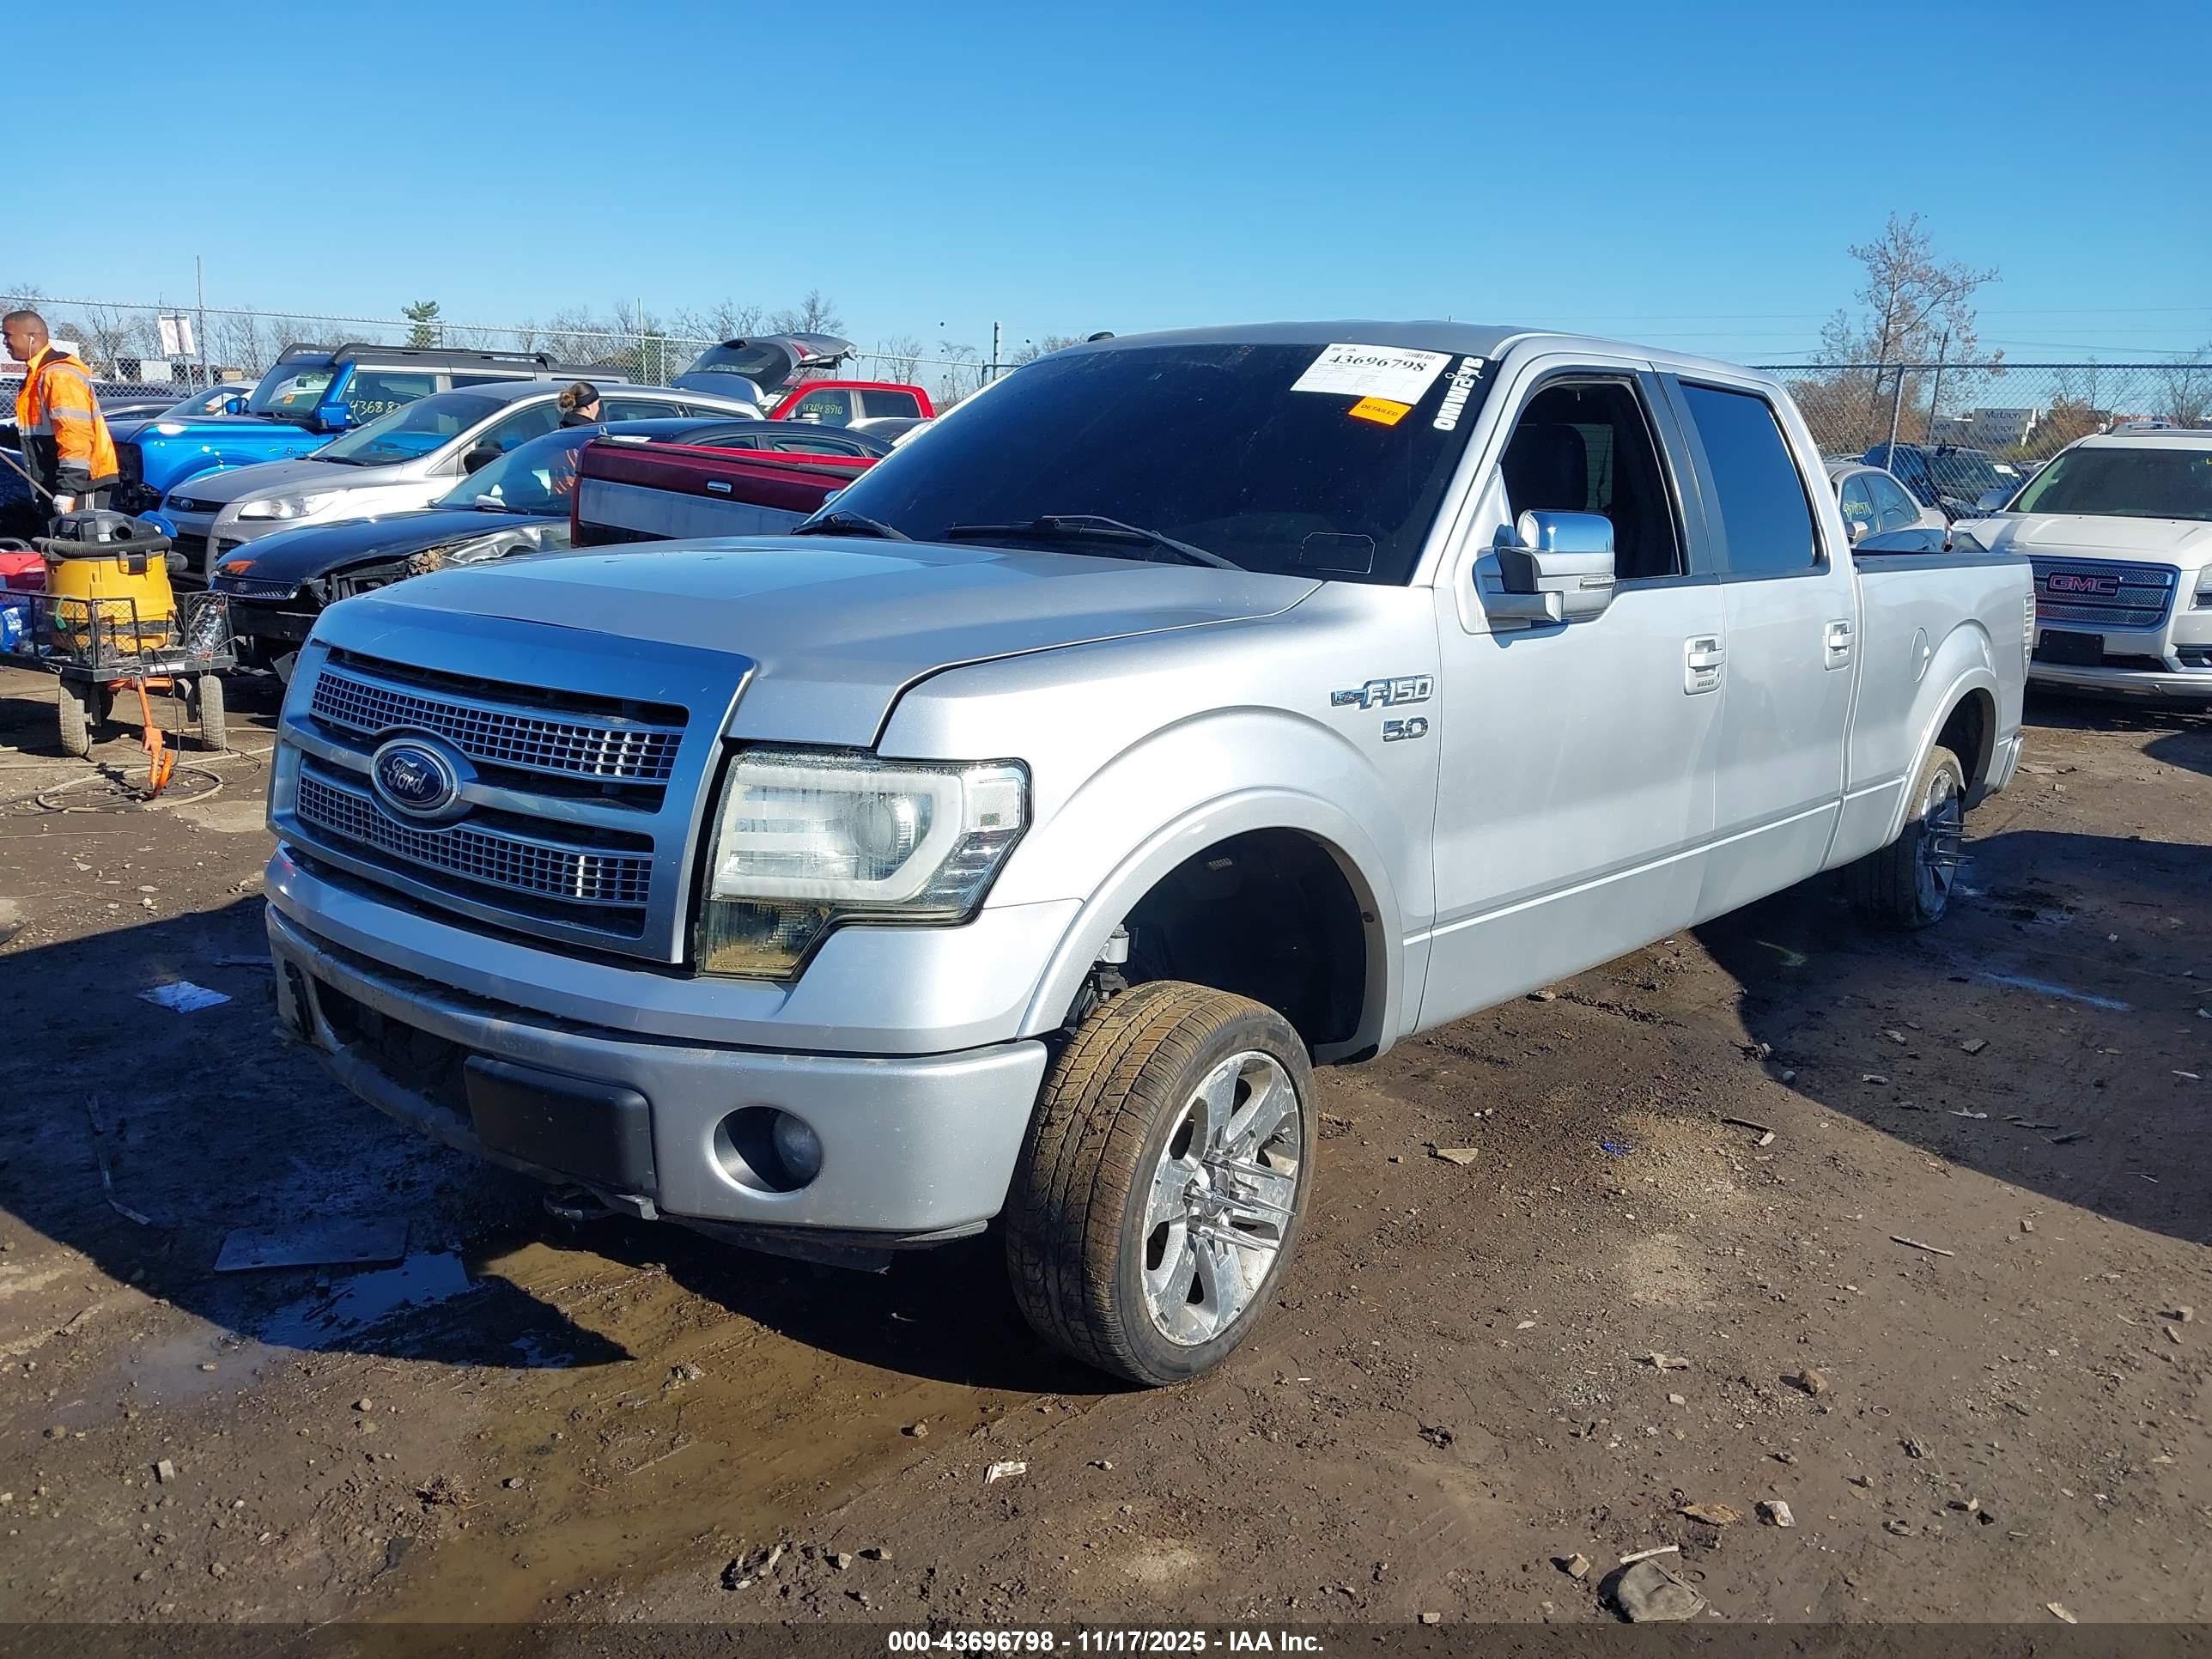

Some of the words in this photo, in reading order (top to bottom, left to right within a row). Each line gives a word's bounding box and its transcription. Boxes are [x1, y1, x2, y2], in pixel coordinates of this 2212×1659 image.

[1328, 355, 1427, 372] 43696798
[1360, 404, 1399, 416] DETAILED
[2049, 574, 2118, 593] GMC
[1382, 717, 1429, 742] 5.0
[383, 757, 428, 794] Ford
